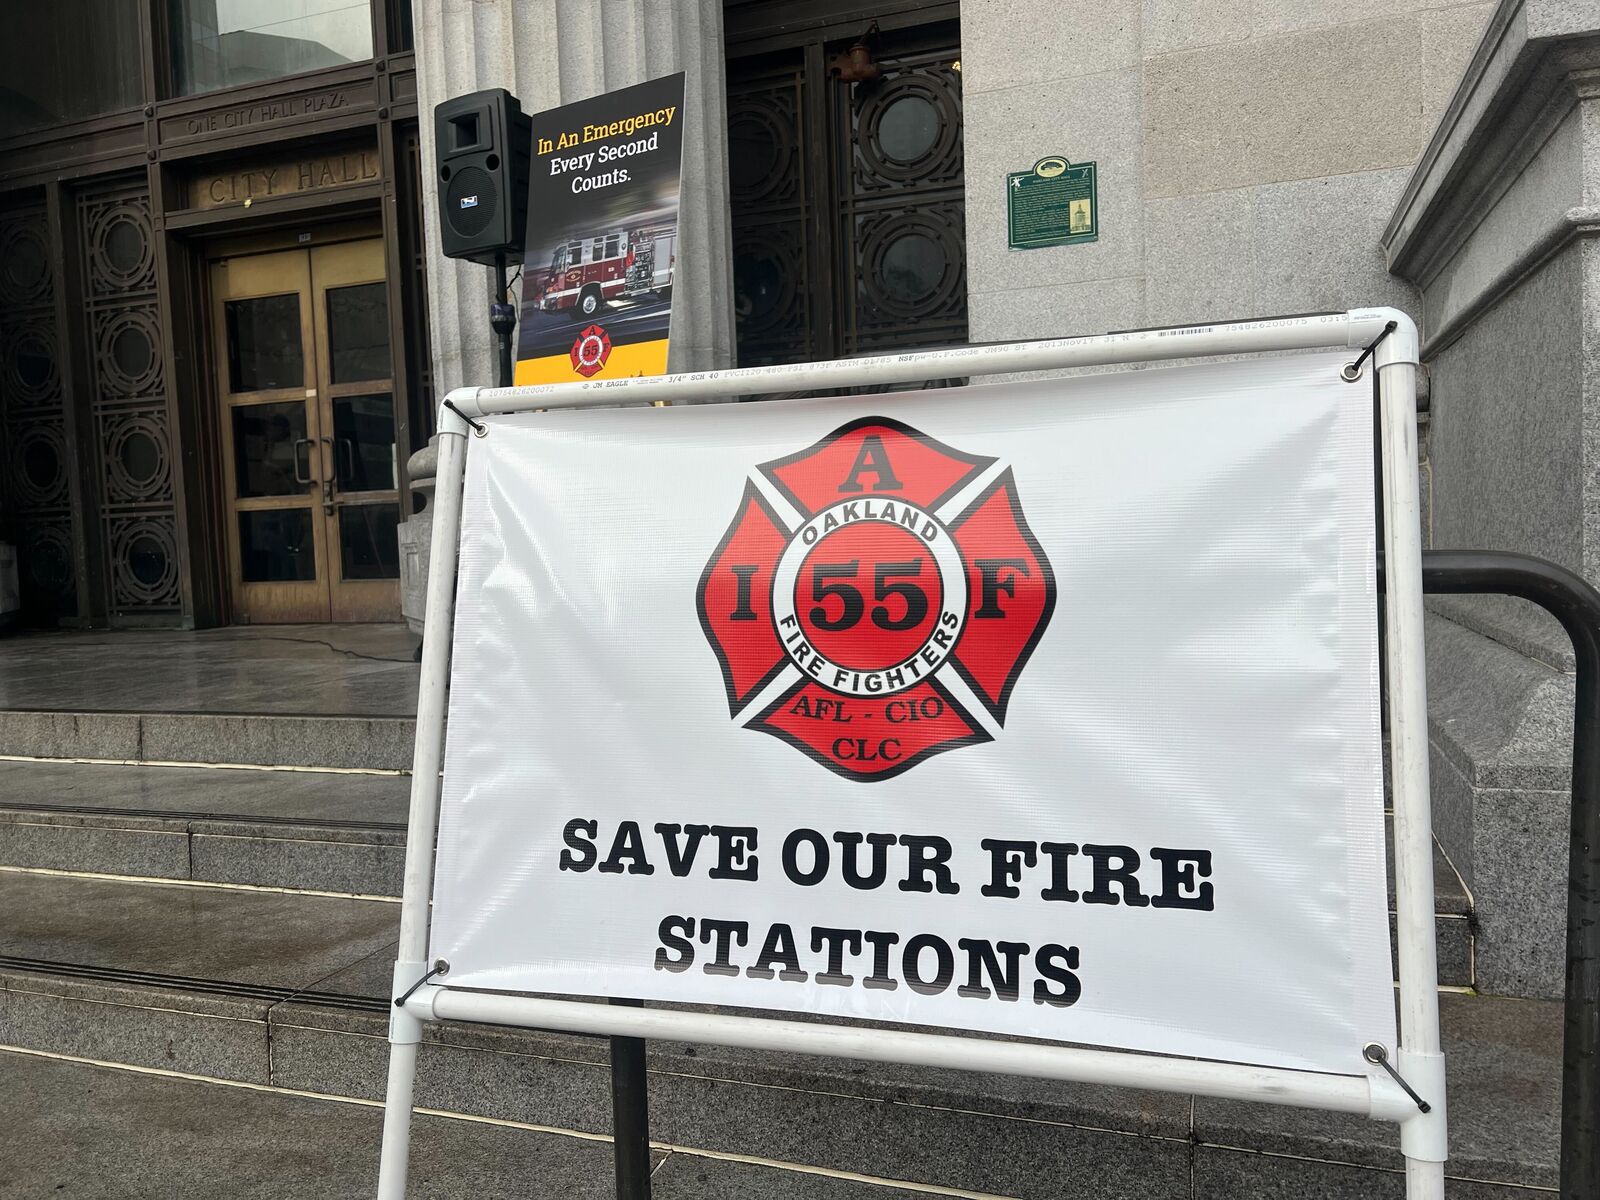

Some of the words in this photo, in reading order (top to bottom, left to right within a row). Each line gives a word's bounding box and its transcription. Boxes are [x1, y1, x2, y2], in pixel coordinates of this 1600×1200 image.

[187, 116, 217, 134] ONE
[224, 109, 253, 128] CITY
[261, 101, 297, 122] HALL
[304, 92, 349, 114] PLAZA
[537, 138, 554, 156] In
[556, 132, 579, 151] An
[582, 106, 676, 144] Emergency
[208, 168, 277, 203] CITY
[297, 152, 378, 190] HALL
[550, 153, 595, 176] Every
[598, 131, 659, 163] Second
[571, 168, 632, 194] Counts.
[583, 344, 598, 357] 55
[592, 381, 603, 389] JM
[606, 379, 629, 388] EAGLE
[668, 375, 687, 383] 3/4"
[690, 373, 705, 381] SCH
[708, 372, 719, 380] 40
[835, 359, 860, 368] ASTM
[838, 435, 904, 494] A
[801, 500, 938, 546] OAKLAND
[730, 564, 758, 621] I
[808, 557, 929, 632] 55
[974, 558, 1030, 619] F
[779, 613, 826, 678] FIRE
[832, 609, 960, 693] FIGHTERS
[789, 695, 853, 723] AFL
[885, 696, 944, 723] CIO
[832, 737, 902, 761] CLC
[559, 817, 759, 882] SAVE
[781, 827, 960, 895] OUR
[980, 838, 1215, 911] FIRE
[654, 914, 1082, 1008] STATIONS
